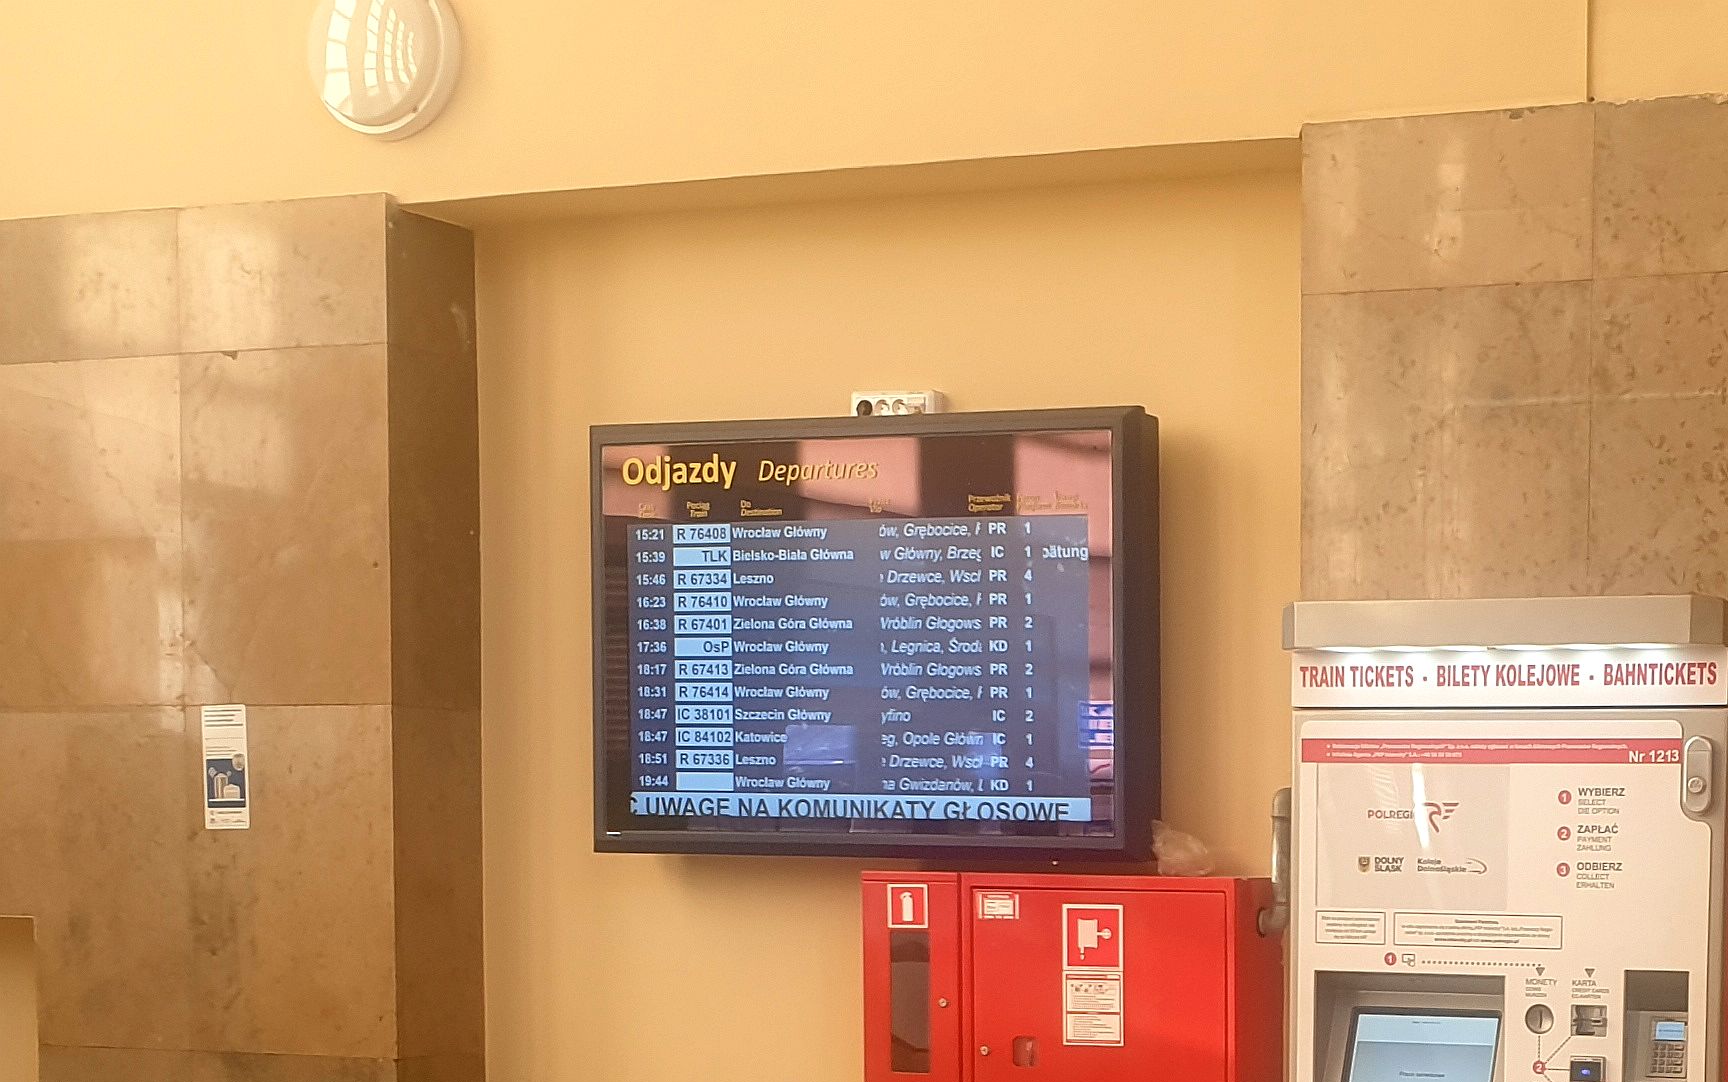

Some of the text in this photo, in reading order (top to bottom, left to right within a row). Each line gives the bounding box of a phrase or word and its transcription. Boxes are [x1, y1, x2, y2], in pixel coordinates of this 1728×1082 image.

[622, 453, 878, 490] Odjazdy Departures
[636, 529, 665, 540] 15:21
[732, 527, 781, 538] Wrocław
[784, 526, 827, 539] Główny
[636, 552, 665, 562] 15:39
[702, 551, 728, 562] TLK
[810, 549, 854, 560] Główna
[637, 575, 666, 585] 15:46
[691, 573, 727, 584] 67334
[733, 573, 774, 584] Leszno
[637, 595, 828, 608] 16:23 76410 Wrocław Główny
[637, 618, 852, 630] 16:38 67401 Zielona Góra Główna
[637, 642, 666, 652] 17:36
[703, 641, 729, 652] OsP
[734, 642, 782, 652] Wrocław
[785, 641, 829, 654] Główny
[638, 664, 853, 675] 18:17 67413 Zielona Góra Główna
[1300, 662, 1717, 687] TRAIN TICKETS BILETY KOLEJOWE BAHNTICKETS
[638, 686, 829, 700] 18:31 76414 Wrocław Główny
[638, 709, 832, 722] 18:47 38101 Szczecin Główny
[639, 731, 667, 742] 18:47
[695, 731, 731, 742] 84102
[736, 732, 788, 742] Katowice
[639, 753, 776, 765] 18:51 67336 Leszno
[1629, 750, 1679, 762] Nr 1213
[640, 776, 831, 790] 19:44 Wrocław Główny
[1578, 788, 1625, 796] WYBIERZ
[738, 798, 769, 817] NA
[778, 798, 935, 819] KOMUNIKATY
[1578, 823, 1618, 834] ZAPŁAĆ
[1577, 862, 1622, 871] ODBIERZ
